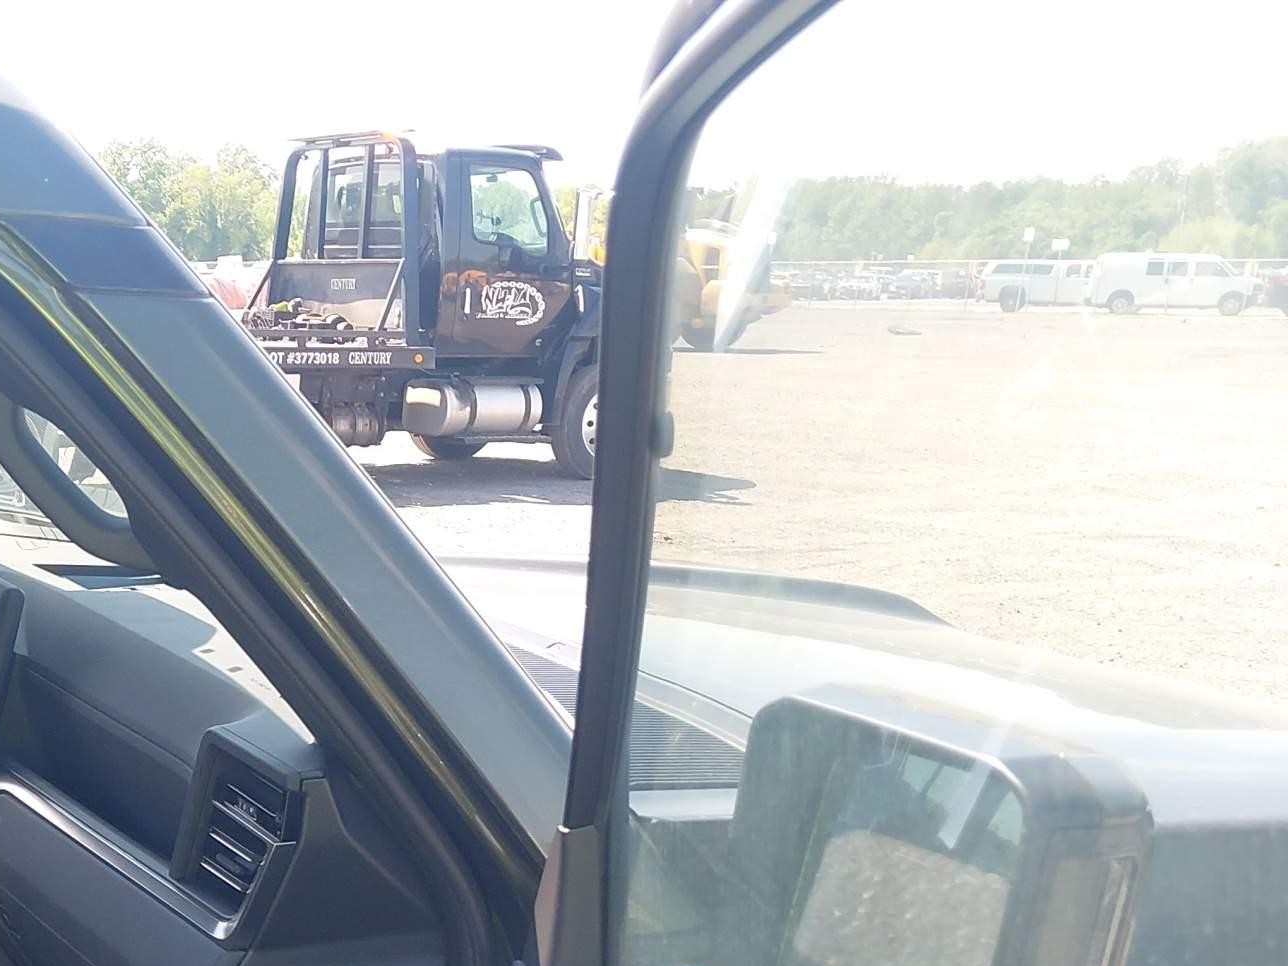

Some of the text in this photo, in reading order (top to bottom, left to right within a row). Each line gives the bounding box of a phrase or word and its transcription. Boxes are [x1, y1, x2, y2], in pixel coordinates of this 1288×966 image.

[269, 351, 340, 365] OT #3773018
[348, 351, 392, 365] CENTURY
